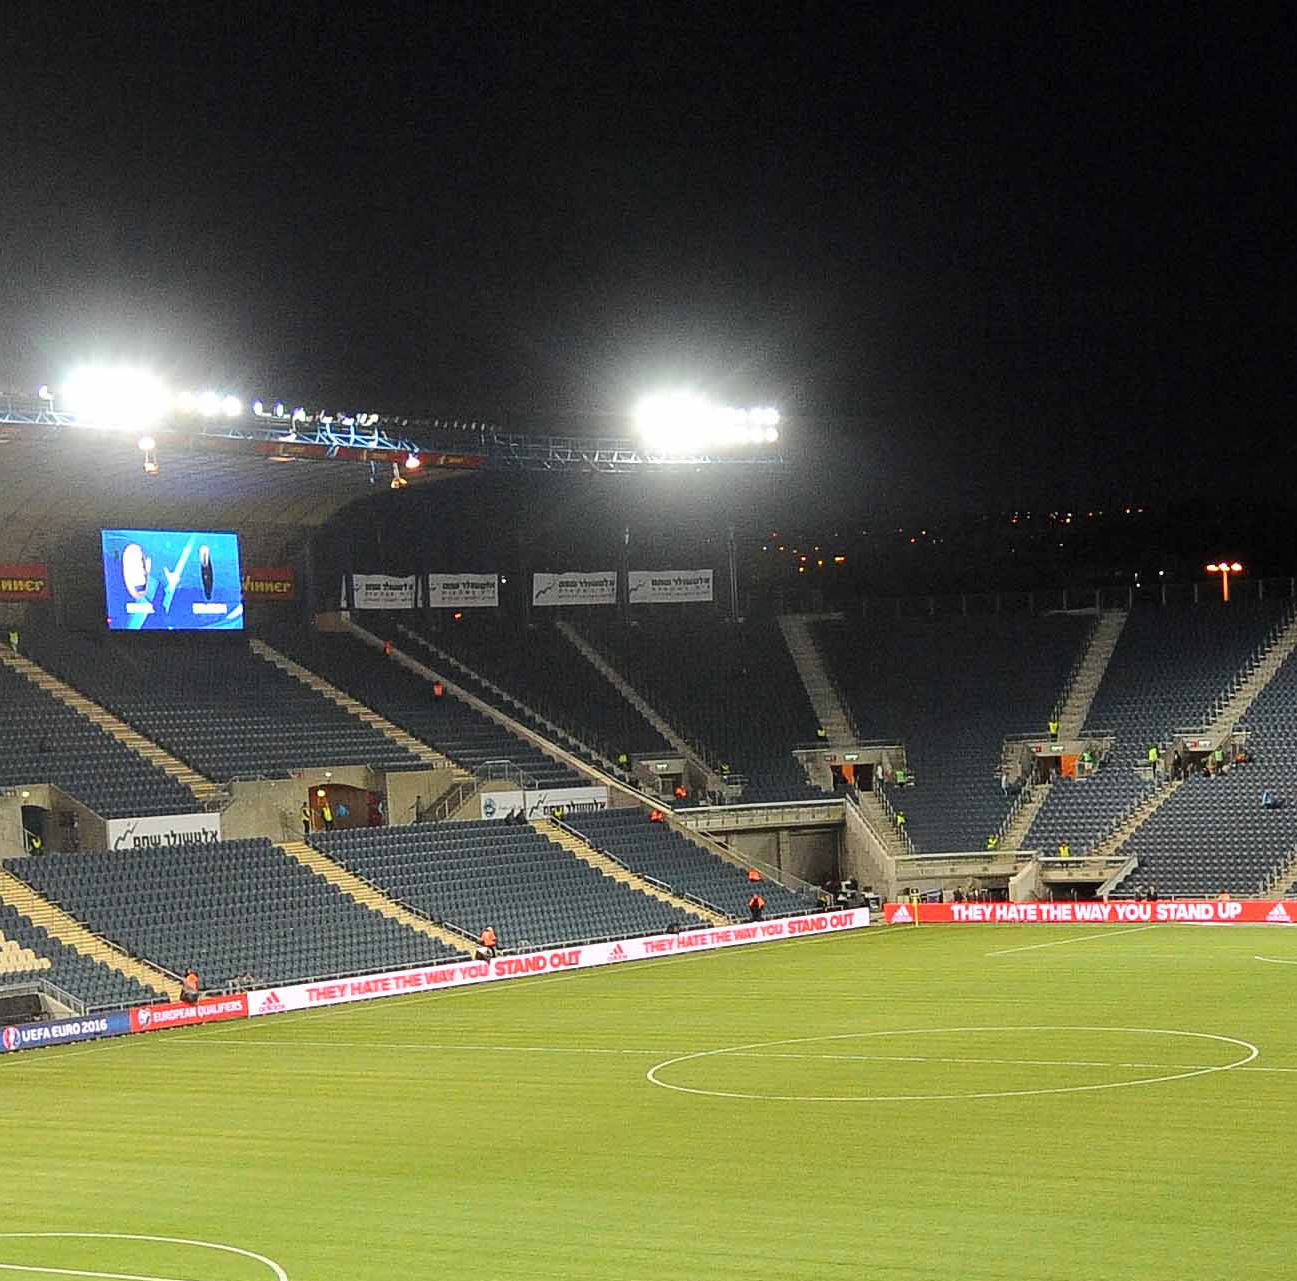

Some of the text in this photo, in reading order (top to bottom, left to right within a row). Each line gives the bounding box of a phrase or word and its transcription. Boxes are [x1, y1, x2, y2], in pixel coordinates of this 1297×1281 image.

[951, 903, 1242, 921] THEY HATE THE WAY YOU STAND UP
[643, 912, 855, 954] THEY HATE THE WAY YOU STAND OUT
[305, 950, 582, 1002] THEY HATE THE WAY YOU STAND OUT
[153, 1000, 243, 1023] EUROPEAN QUALIFIERS
[22, 1018, 108, 1042] UEFA EURO 2016
